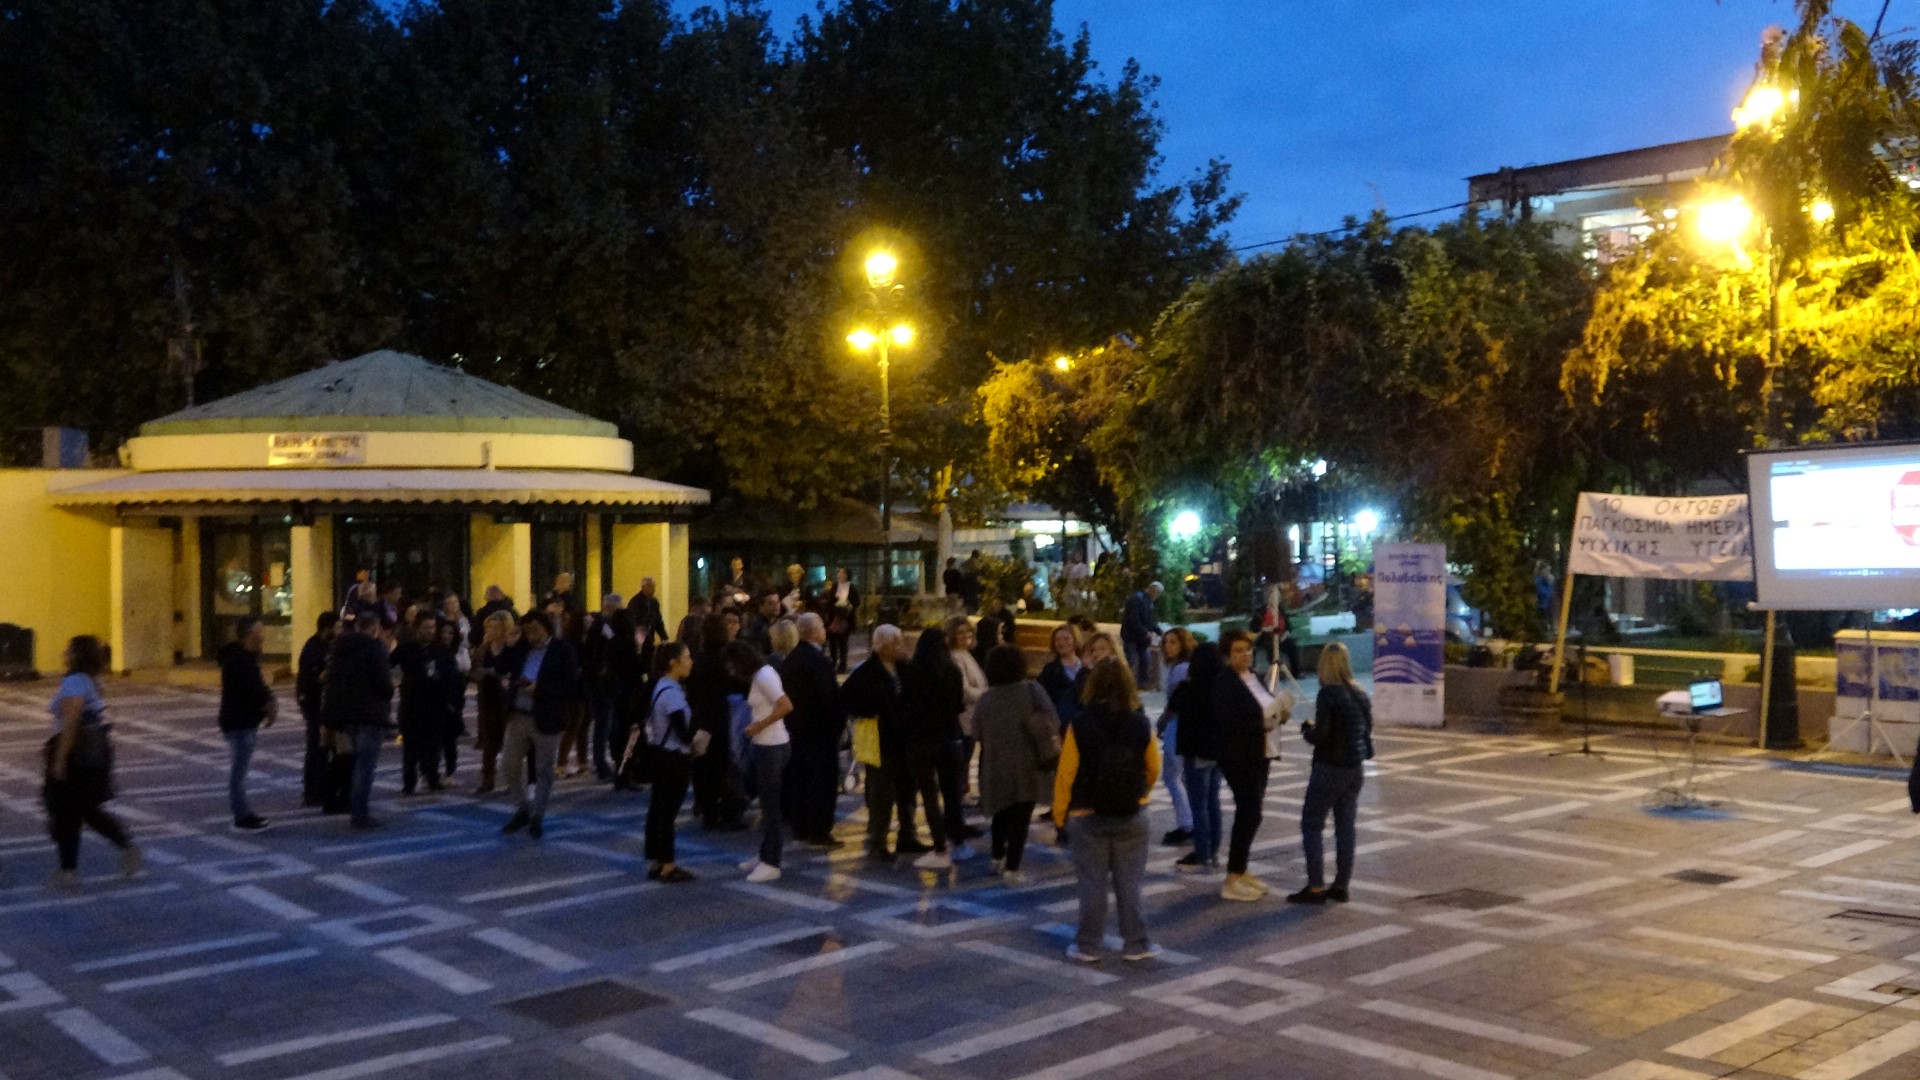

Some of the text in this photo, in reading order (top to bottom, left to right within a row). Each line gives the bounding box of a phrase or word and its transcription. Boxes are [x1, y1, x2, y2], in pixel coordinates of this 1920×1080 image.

[1599, 497, 1623, 514] 10
[1579, 515, 1674, 535] ΠΑΓΚΟΣΜΙΑ
[1578, 536, 1661, 556] ΨΥΧΙΚΗΣ
